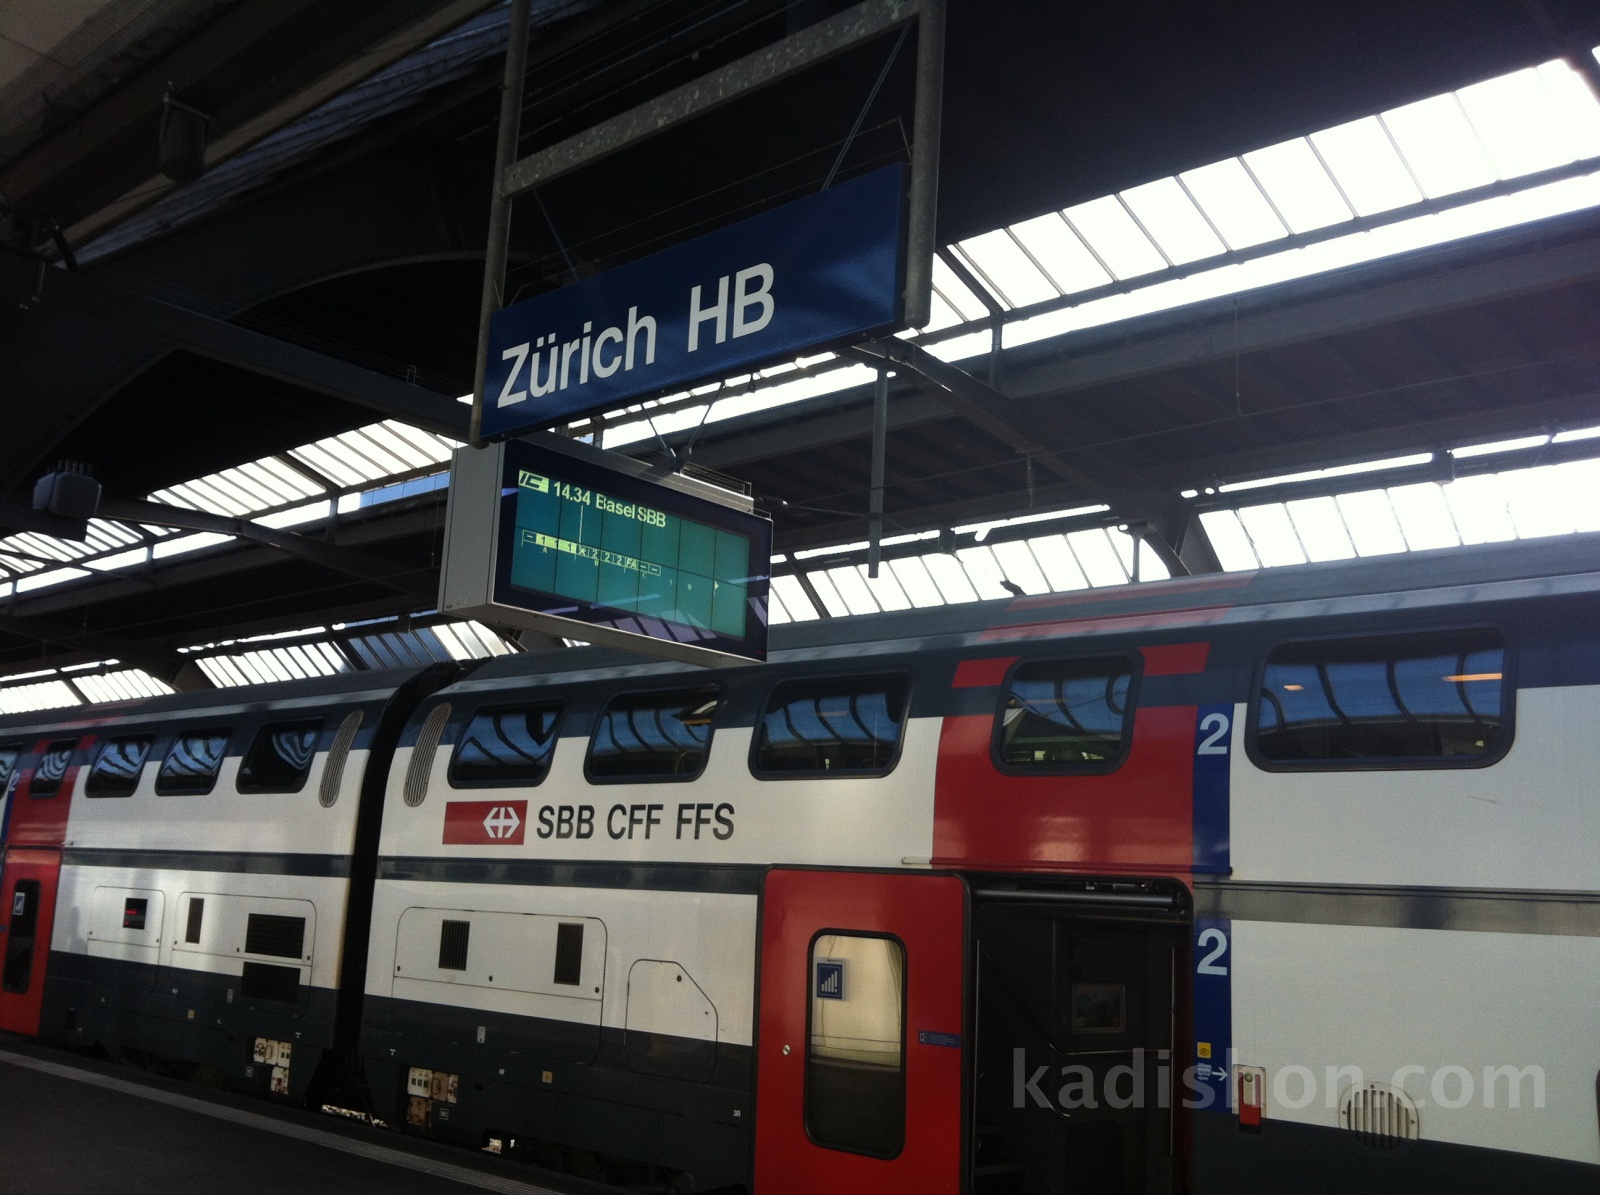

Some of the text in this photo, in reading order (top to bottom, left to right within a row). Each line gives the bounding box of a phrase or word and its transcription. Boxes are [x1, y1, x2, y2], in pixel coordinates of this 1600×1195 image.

[497, 263, 775, 408] Zürich HB
[519, 472, 666, 528] IC 14.34 Basel SBB
[592, 549, 598, 559] 2
[604, 553, 610, 561] 2
[616, 556, 622, 565] 2
[626, 558, 638, 569] FA
[1197, 713, 1230, 755] 2
[536, 803, 735, 841] SBB CFF FFS
[1197, 928, 1228, 976] 2
